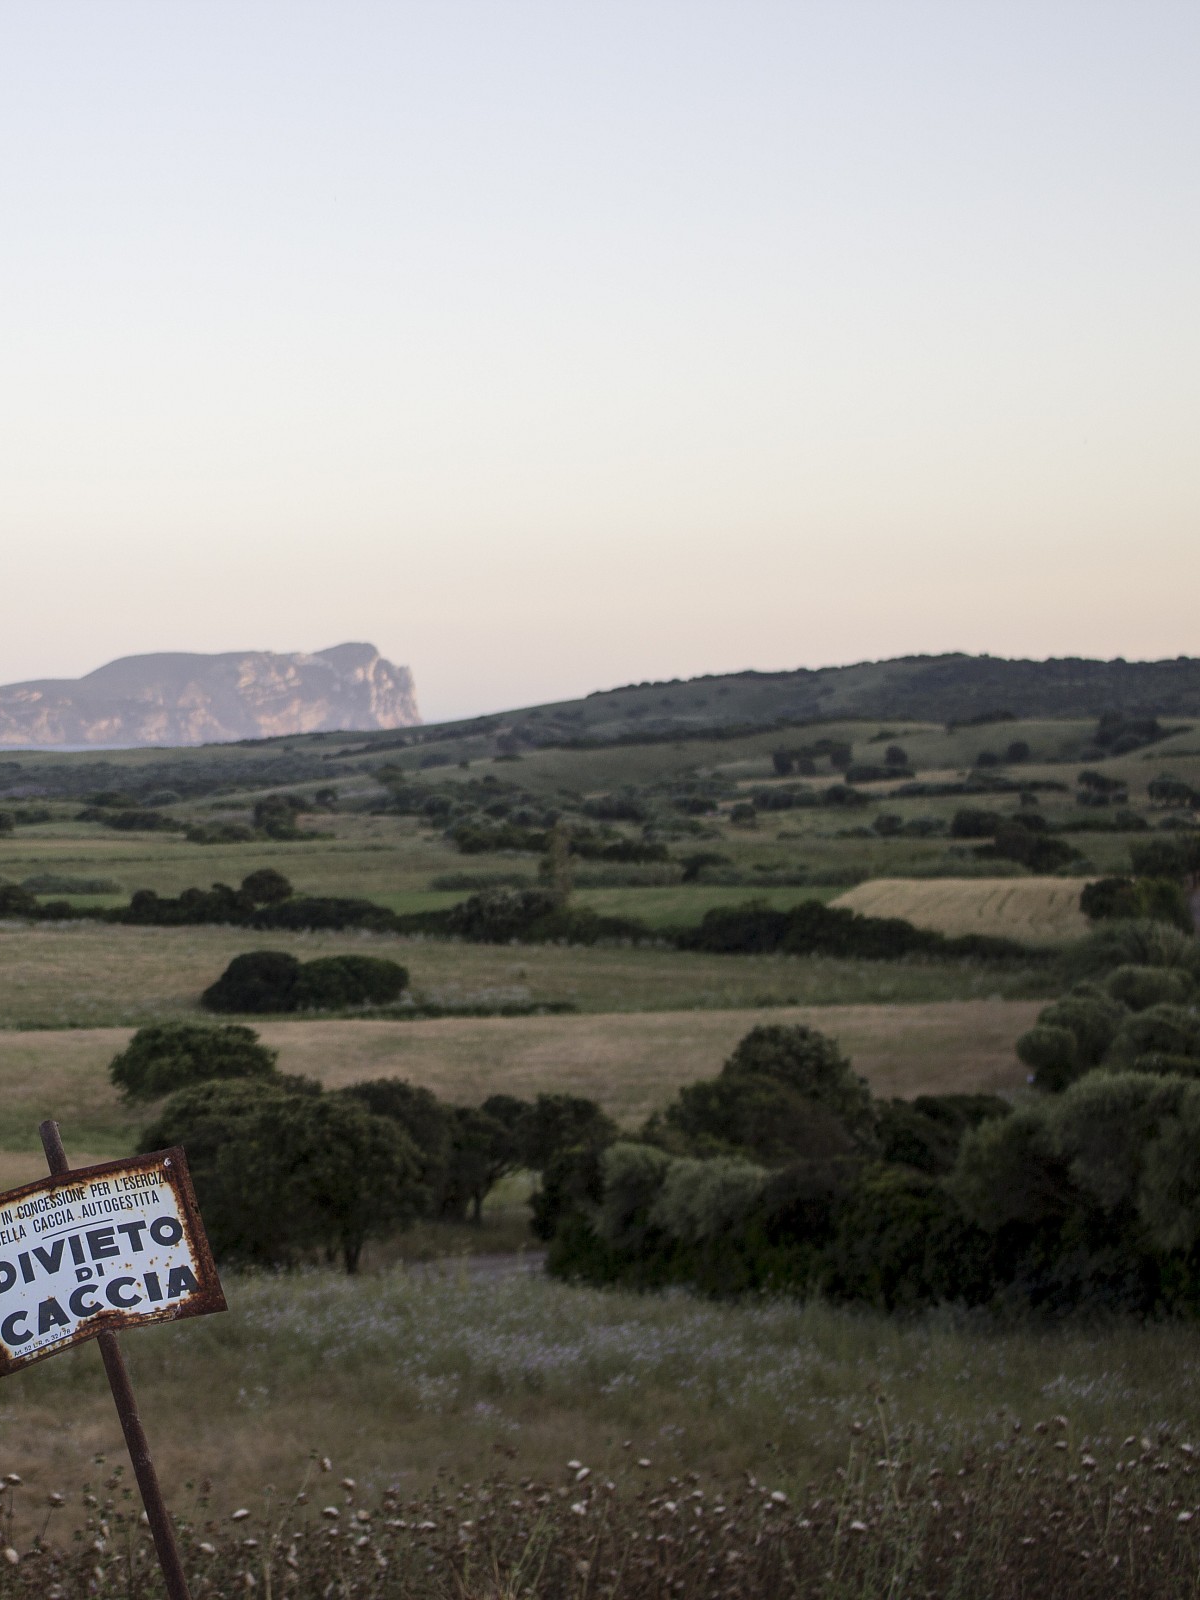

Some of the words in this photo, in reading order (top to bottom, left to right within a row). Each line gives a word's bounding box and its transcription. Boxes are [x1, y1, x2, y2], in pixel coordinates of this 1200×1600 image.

[1, 1210, 13, 1225] IN
[17, 1186, 87, 1219] CONCESSIONE
[90, 1182, 111, 1197] PER
[33, 1209, 75, 1233] CACCIA
[82, 1190, 160, 1218] AUTOGESTITA
[75, 1263, 105, 1282] DI
[1, 1266, 198, 1346] CACCIA
